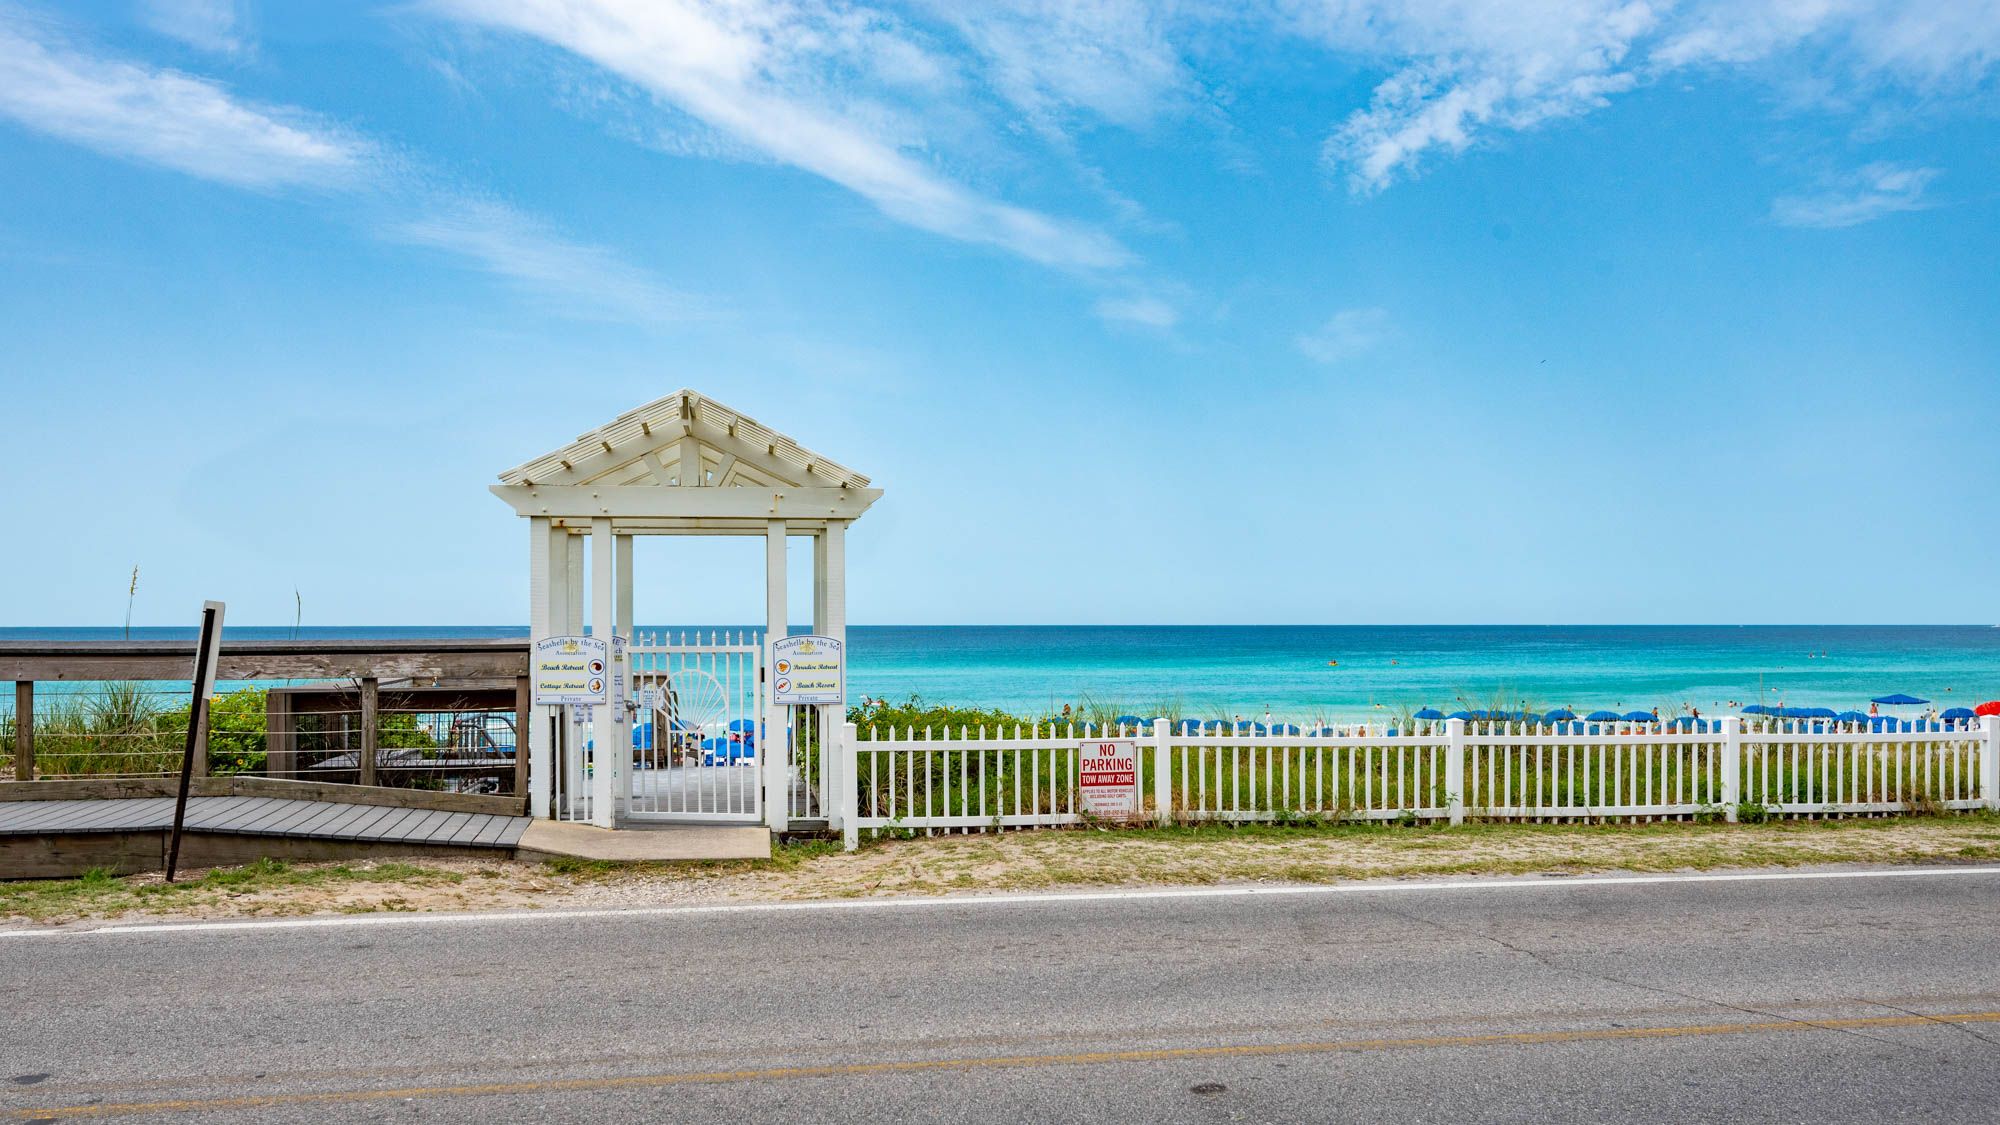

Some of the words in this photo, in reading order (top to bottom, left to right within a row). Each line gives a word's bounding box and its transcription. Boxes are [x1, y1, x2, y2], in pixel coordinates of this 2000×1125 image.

[570, 638, 578, 646] by
[594, 642, 604, 650] Sea
[806, 638, 815, 646] by
[830, 642, 840, 650] Sea
[1100, 744, 1116, 756] NO
[1082, 758, 1132, 771] PARKING
[1082, 775, 1096, 784] TOW
[1098, 774, 1116, 784] AWAY
[1116, 774, 1134, 782] ZONE
